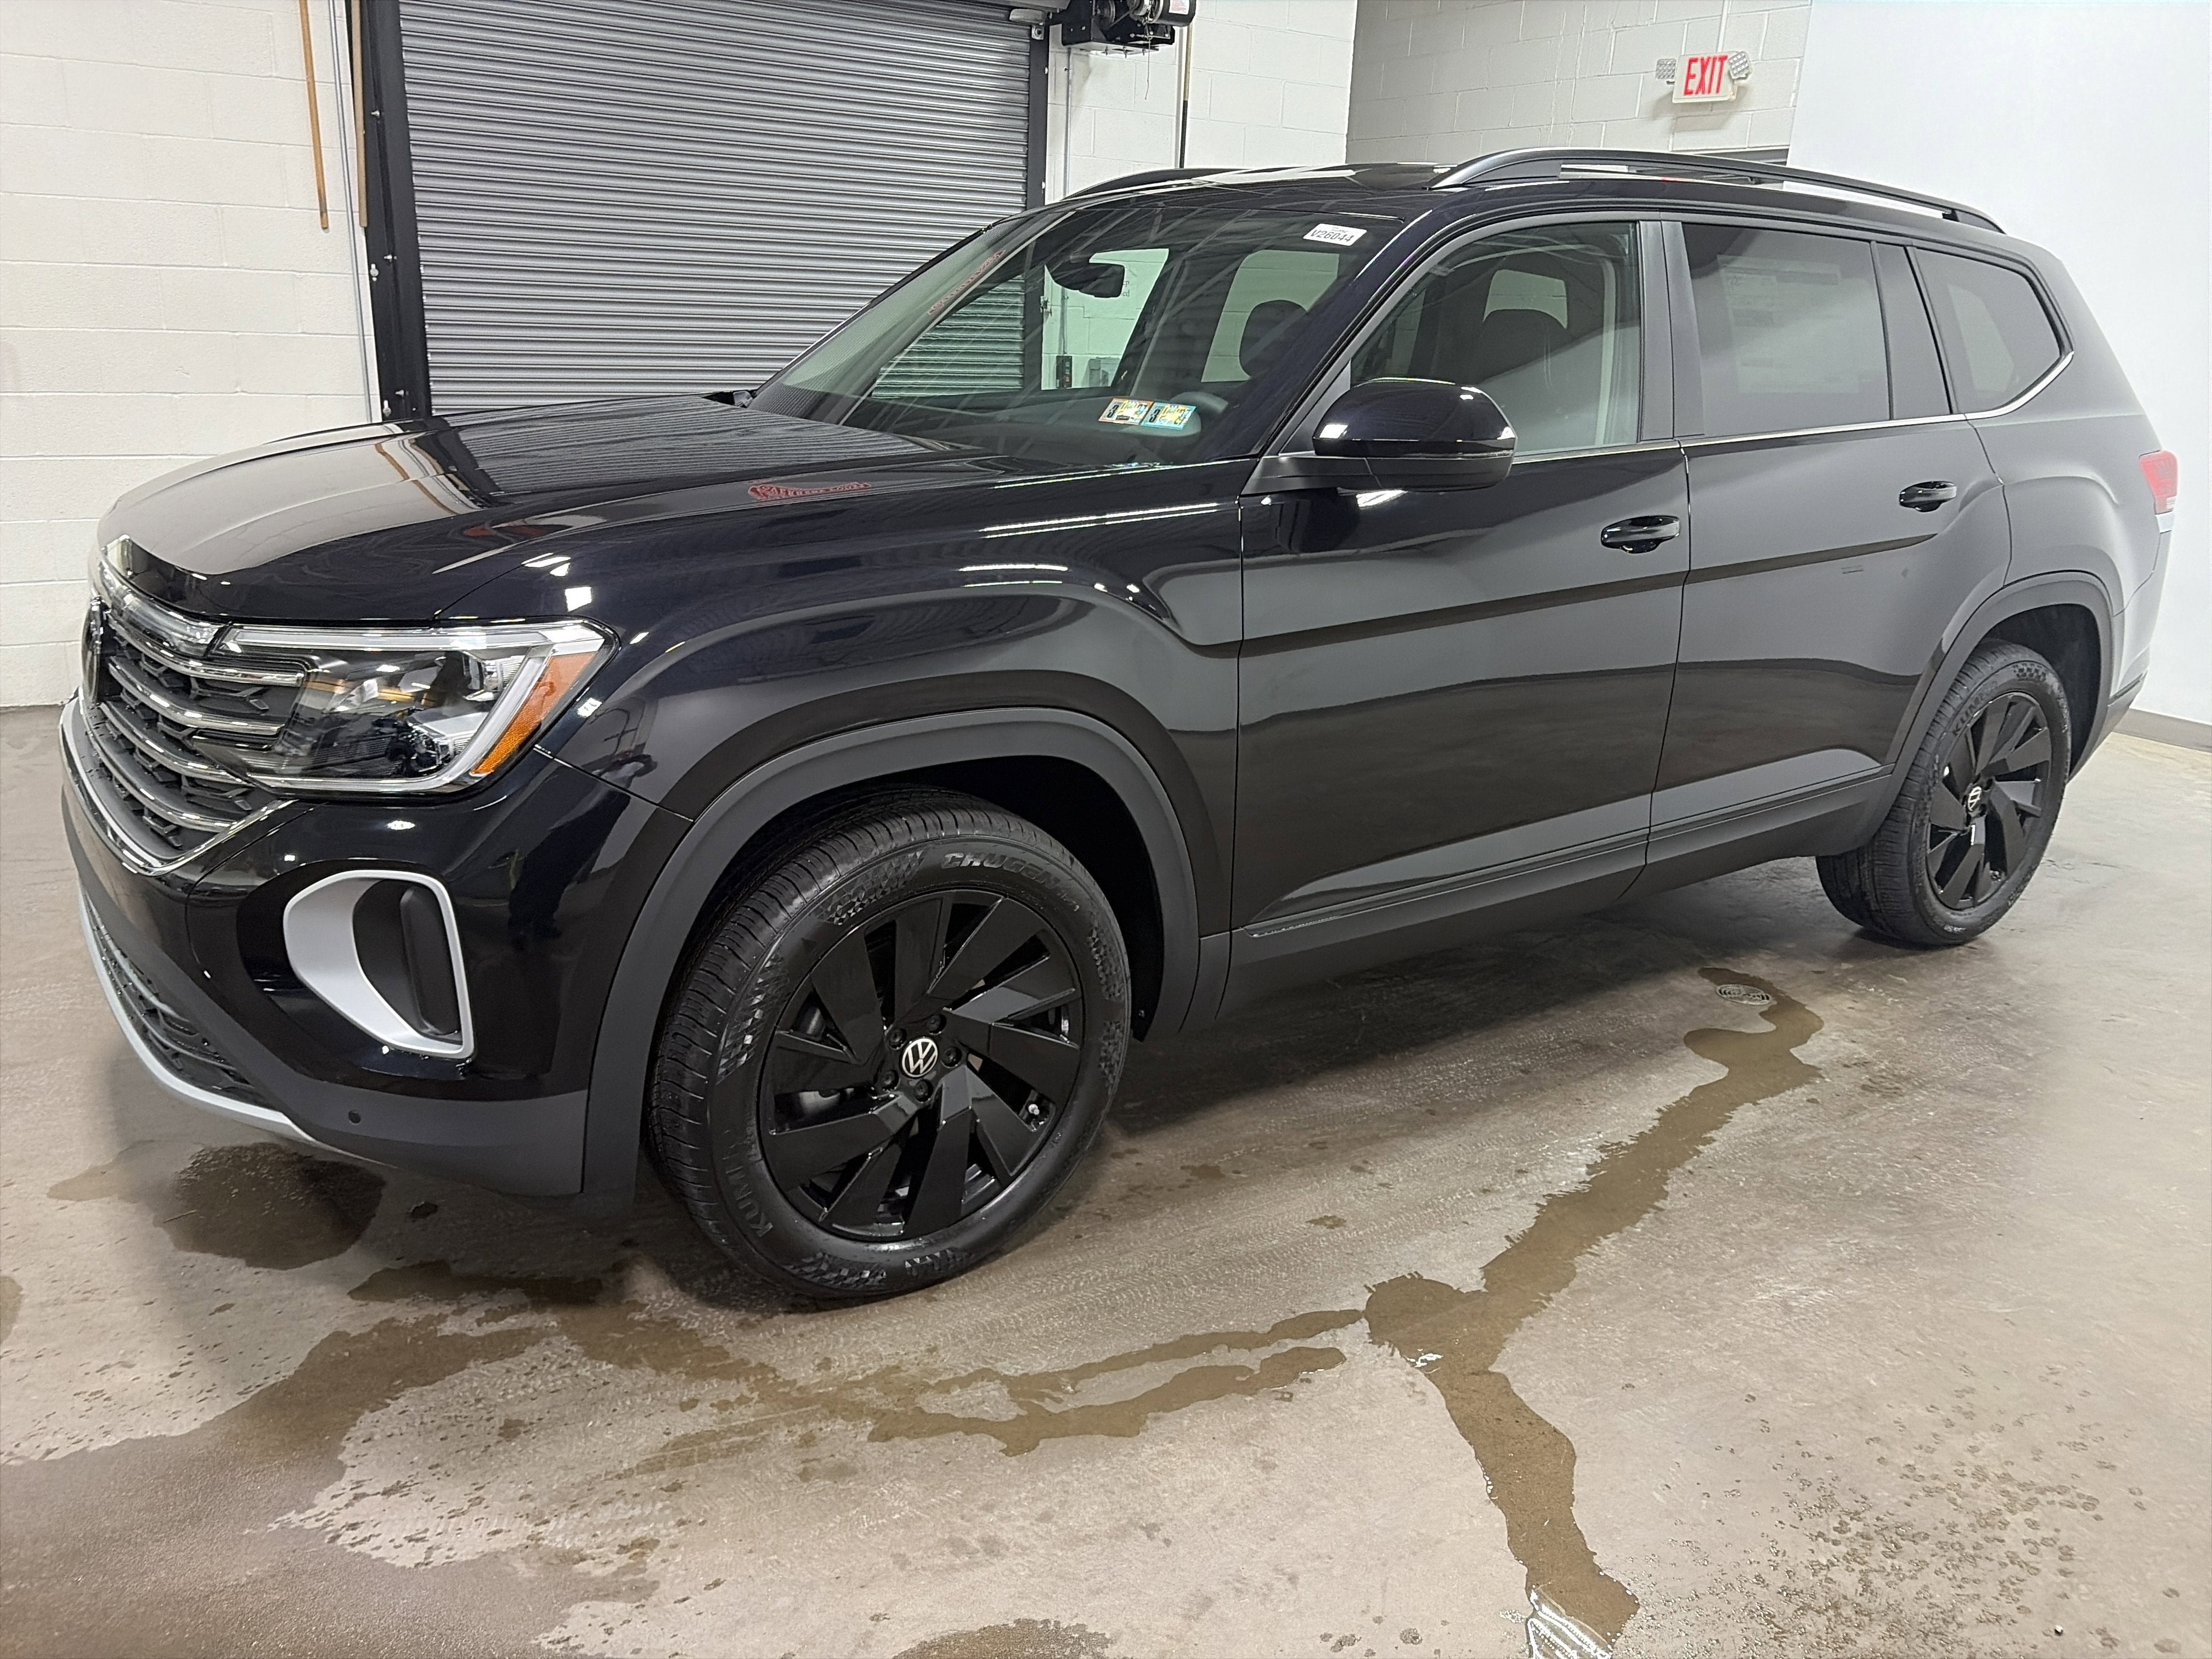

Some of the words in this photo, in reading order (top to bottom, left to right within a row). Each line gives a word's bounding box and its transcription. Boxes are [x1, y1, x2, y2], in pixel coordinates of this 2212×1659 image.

[1683, 54, 1729, 96] EXIT
[1310, 229, 1355, 242] V26044
[1107, 404, 1120, 418] 3
[1148, 409, 1161, 422] 3
[902, 1038, 938, 1077] VW
